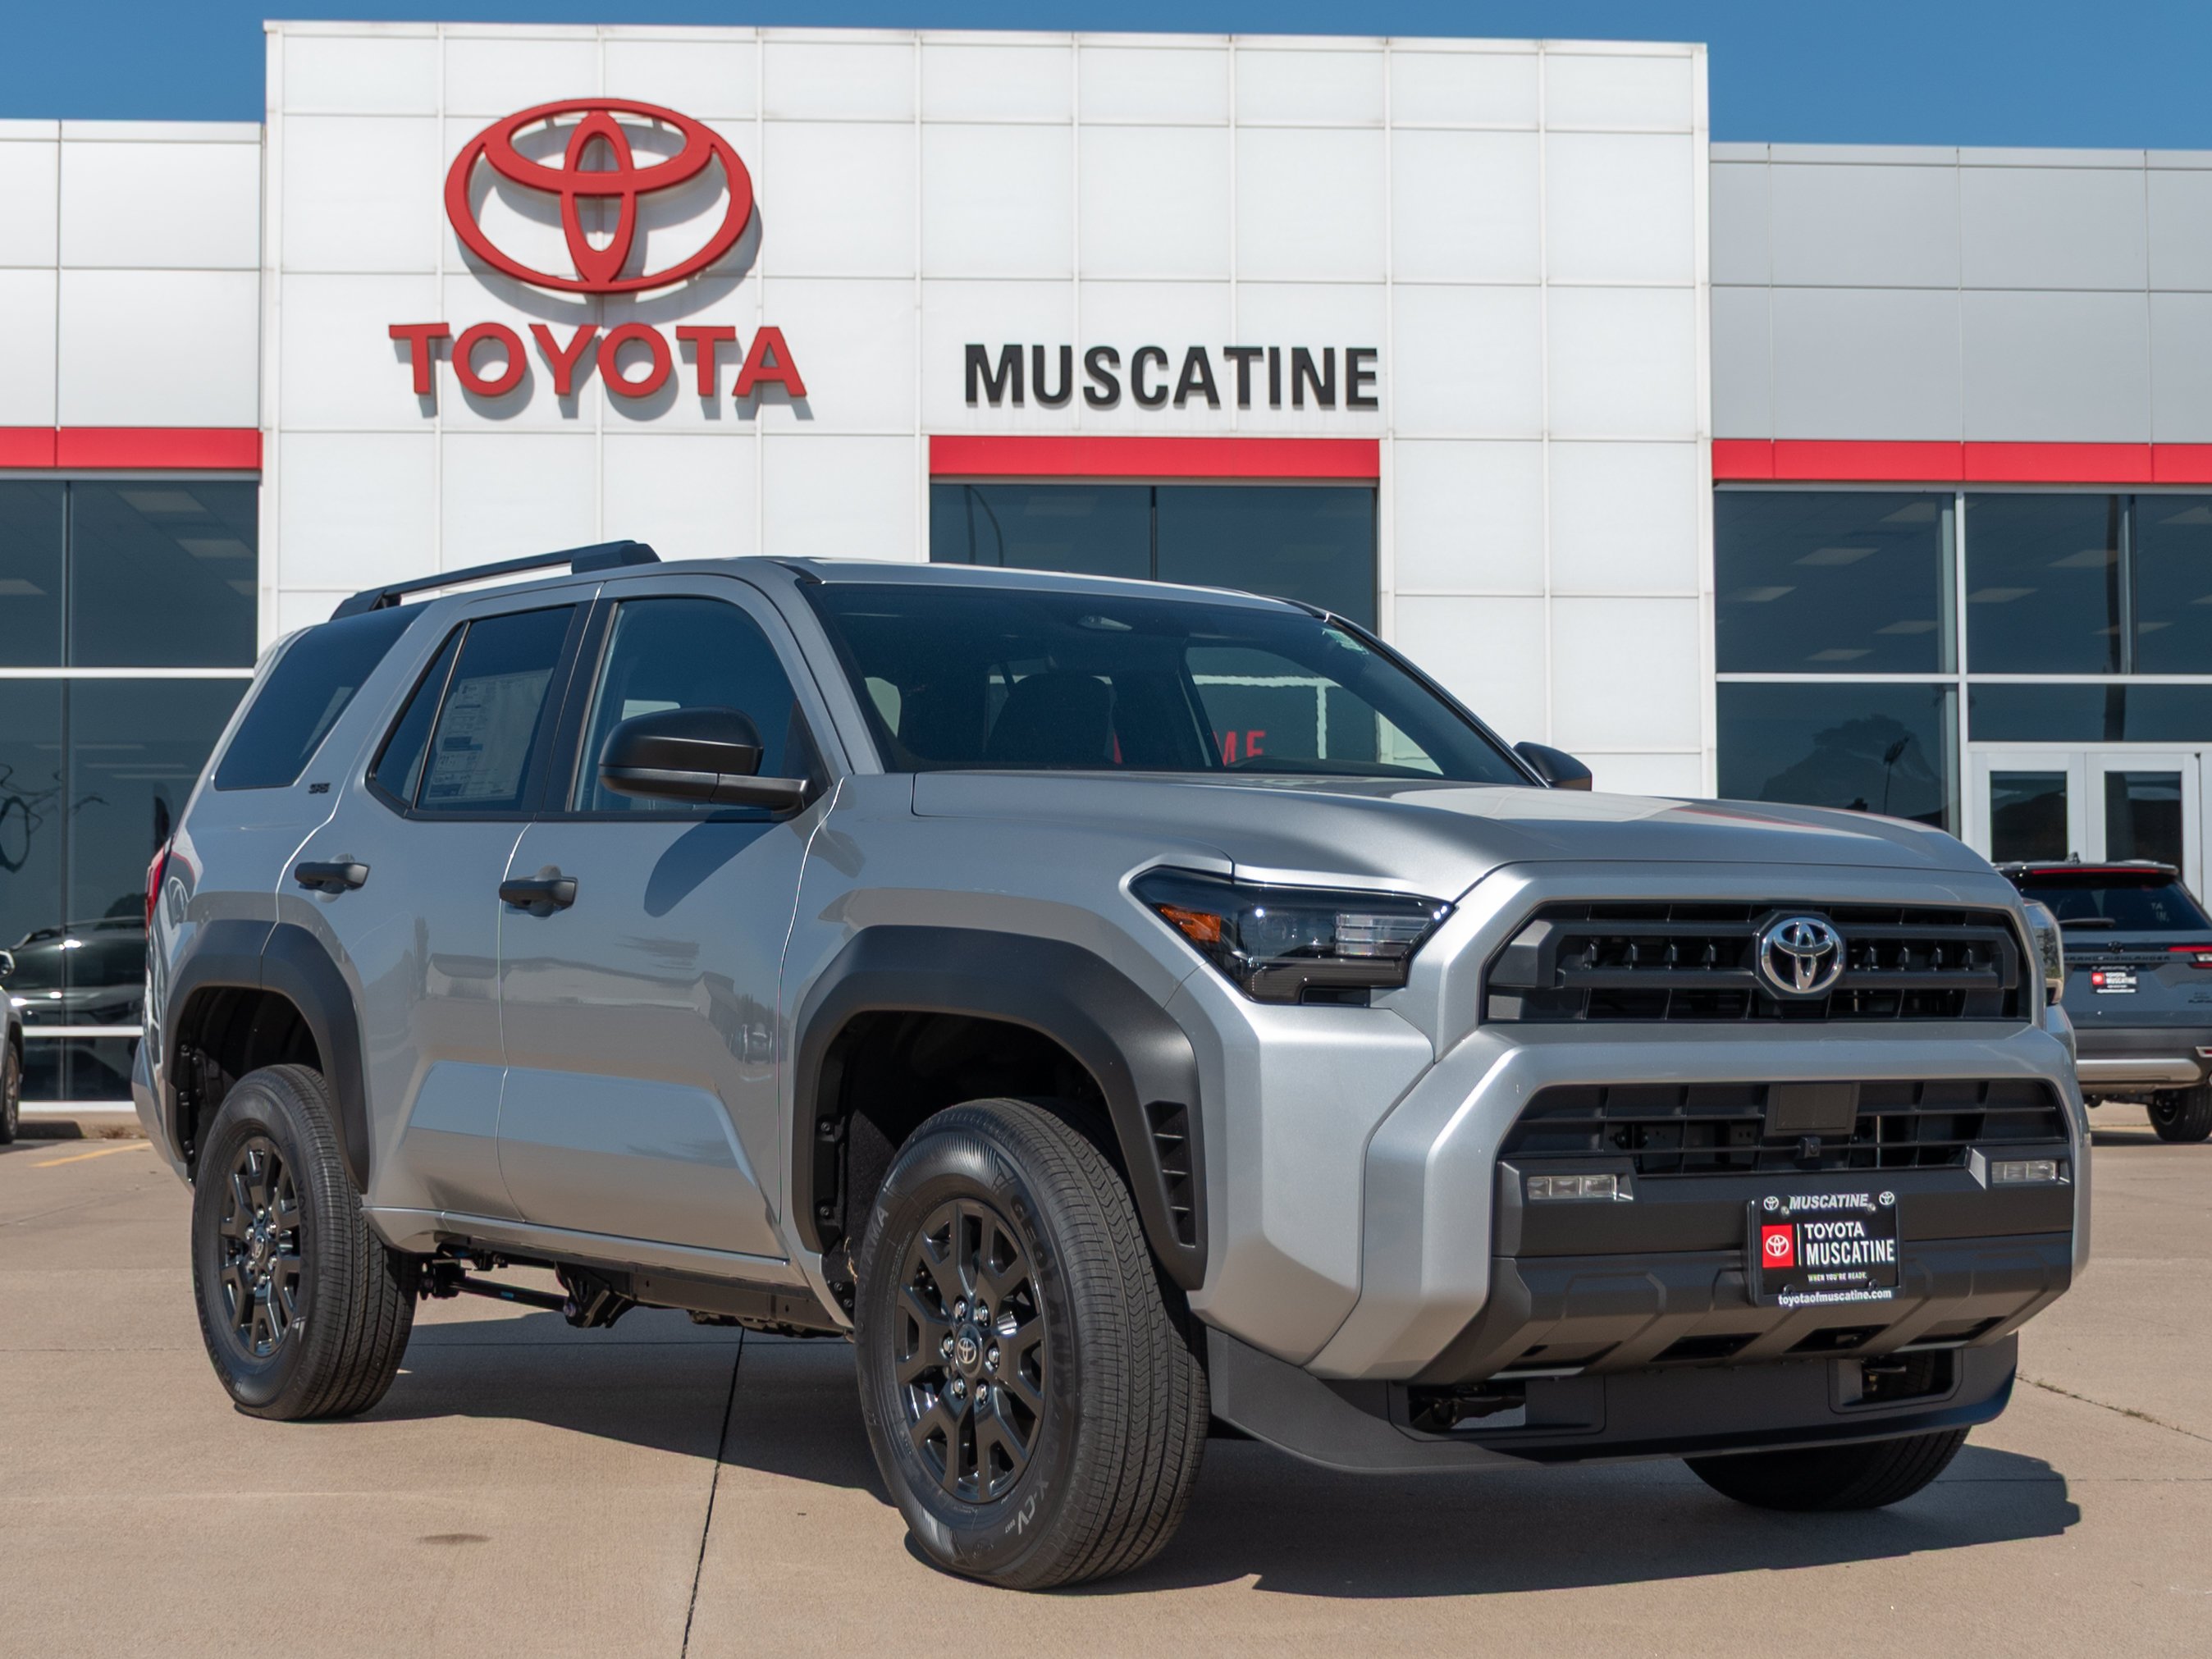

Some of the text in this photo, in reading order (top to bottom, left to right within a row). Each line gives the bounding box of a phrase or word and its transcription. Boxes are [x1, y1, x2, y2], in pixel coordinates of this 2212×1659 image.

[389, 322, 807, 398] TOYOTA
[965, 344, 1378, 407] MUSCATINE
[1789, 1194, 1869, 1210] MUSCATINE
[1804, 1221, 1865, 1239] TOYOTA
[1806, 1240, 1895, 1266] MUSCATINE
[1778, 1289, 1892, 1306] toyotaofmuscatine.com
